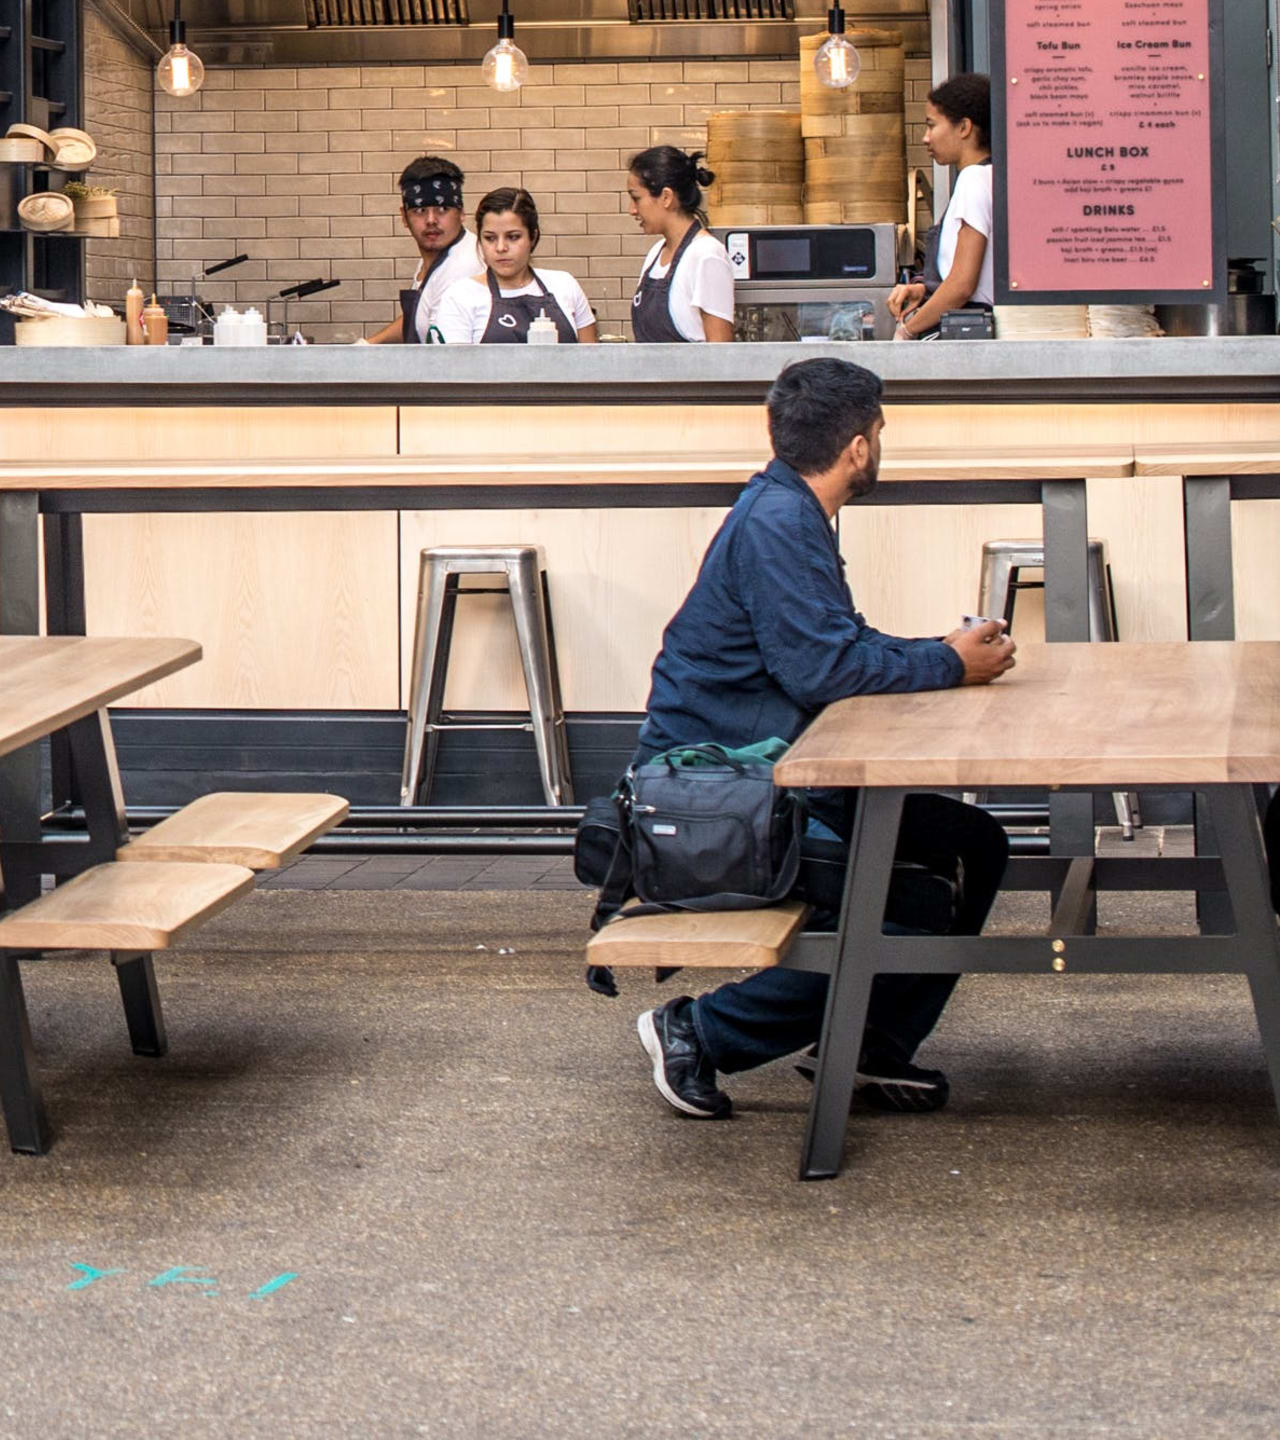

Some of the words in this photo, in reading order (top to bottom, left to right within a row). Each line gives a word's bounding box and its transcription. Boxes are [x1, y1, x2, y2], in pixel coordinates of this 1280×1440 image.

[1036, 42, 1058, 50] Tofu
[1061, 41, 1081, 49] Bun
[1116, 40, 1132, 49] Ice
[1134, 39, 1169, 48] Cream
[1171, 39, 1192, 48] Bun
[1067, 147, 1114, 158] LUNCH
[1119, 146, 1149, 157] BOX
[1083, 205, 1134, 216] DRINKS
